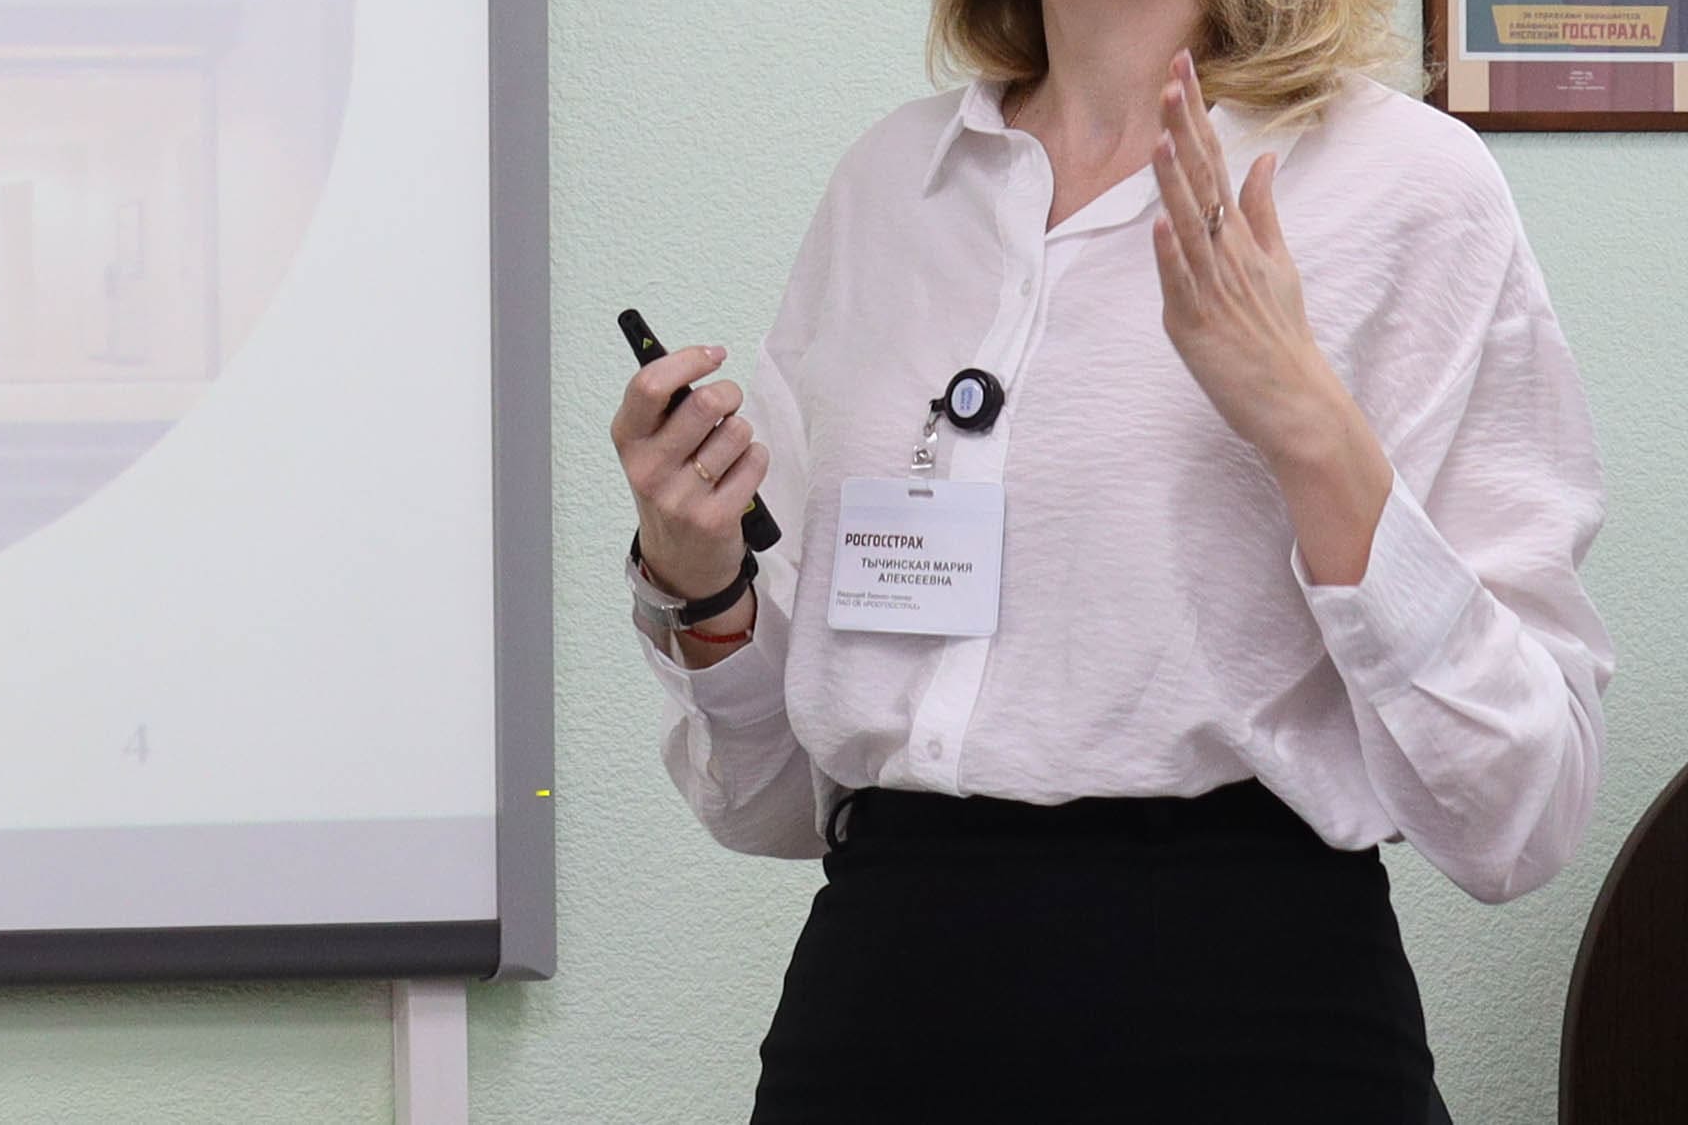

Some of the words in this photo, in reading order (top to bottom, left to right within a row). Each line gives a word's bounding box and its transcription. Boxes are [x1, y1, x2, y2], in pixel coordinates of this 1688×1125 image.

[1562, 23, 1656, 41] ГОССТРАХА.
[845, 533, 924, 550] РОСГОССТРАХ
[862, 557, 930, 571] ТЫЧИНСКАЯ
[933, 561, 973, 574] МАРИЯ
[878, 572, 953, 587] АЛЕКСЕЕВНА
[120, 723, 152, 766] 4
